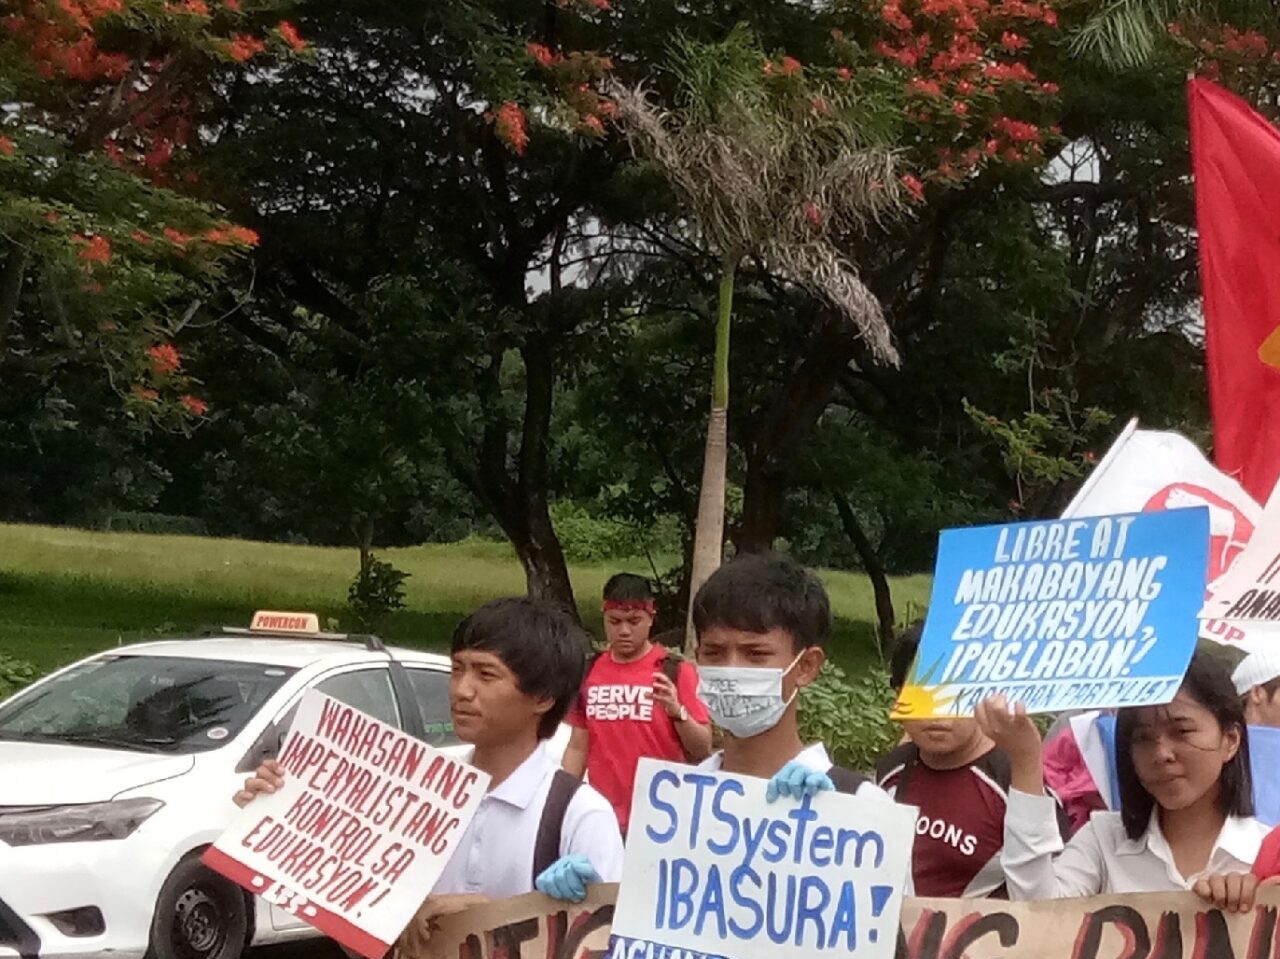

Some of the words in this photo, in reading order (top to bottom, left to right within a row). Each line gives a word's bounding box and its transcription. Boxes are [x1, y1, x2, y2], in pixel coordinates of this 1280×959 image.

[993, 520, 1088, 563] LIBRE
[1089, 516, 1137, 559] AT
[953, 555, 1169, 606] MAKABAYANG
[950, 599, 1156, 642] EDUKASYON,
[941, 636, 1159, 684] IPAGLABAN!
[587, 684, 653, 705] SERVE
[1061, 678, 1180, 705] PARTYLIST
[315, 697, 420, 783] WAKASAN
[419, 757, 479, 810] ANG
[284, 791, 374, 869] KONTROL
[374, 847, 416, 881] SA
[240, 815, 393, 919] EDUKASYON!
[655, 858, 893, 952] IBASURA!
